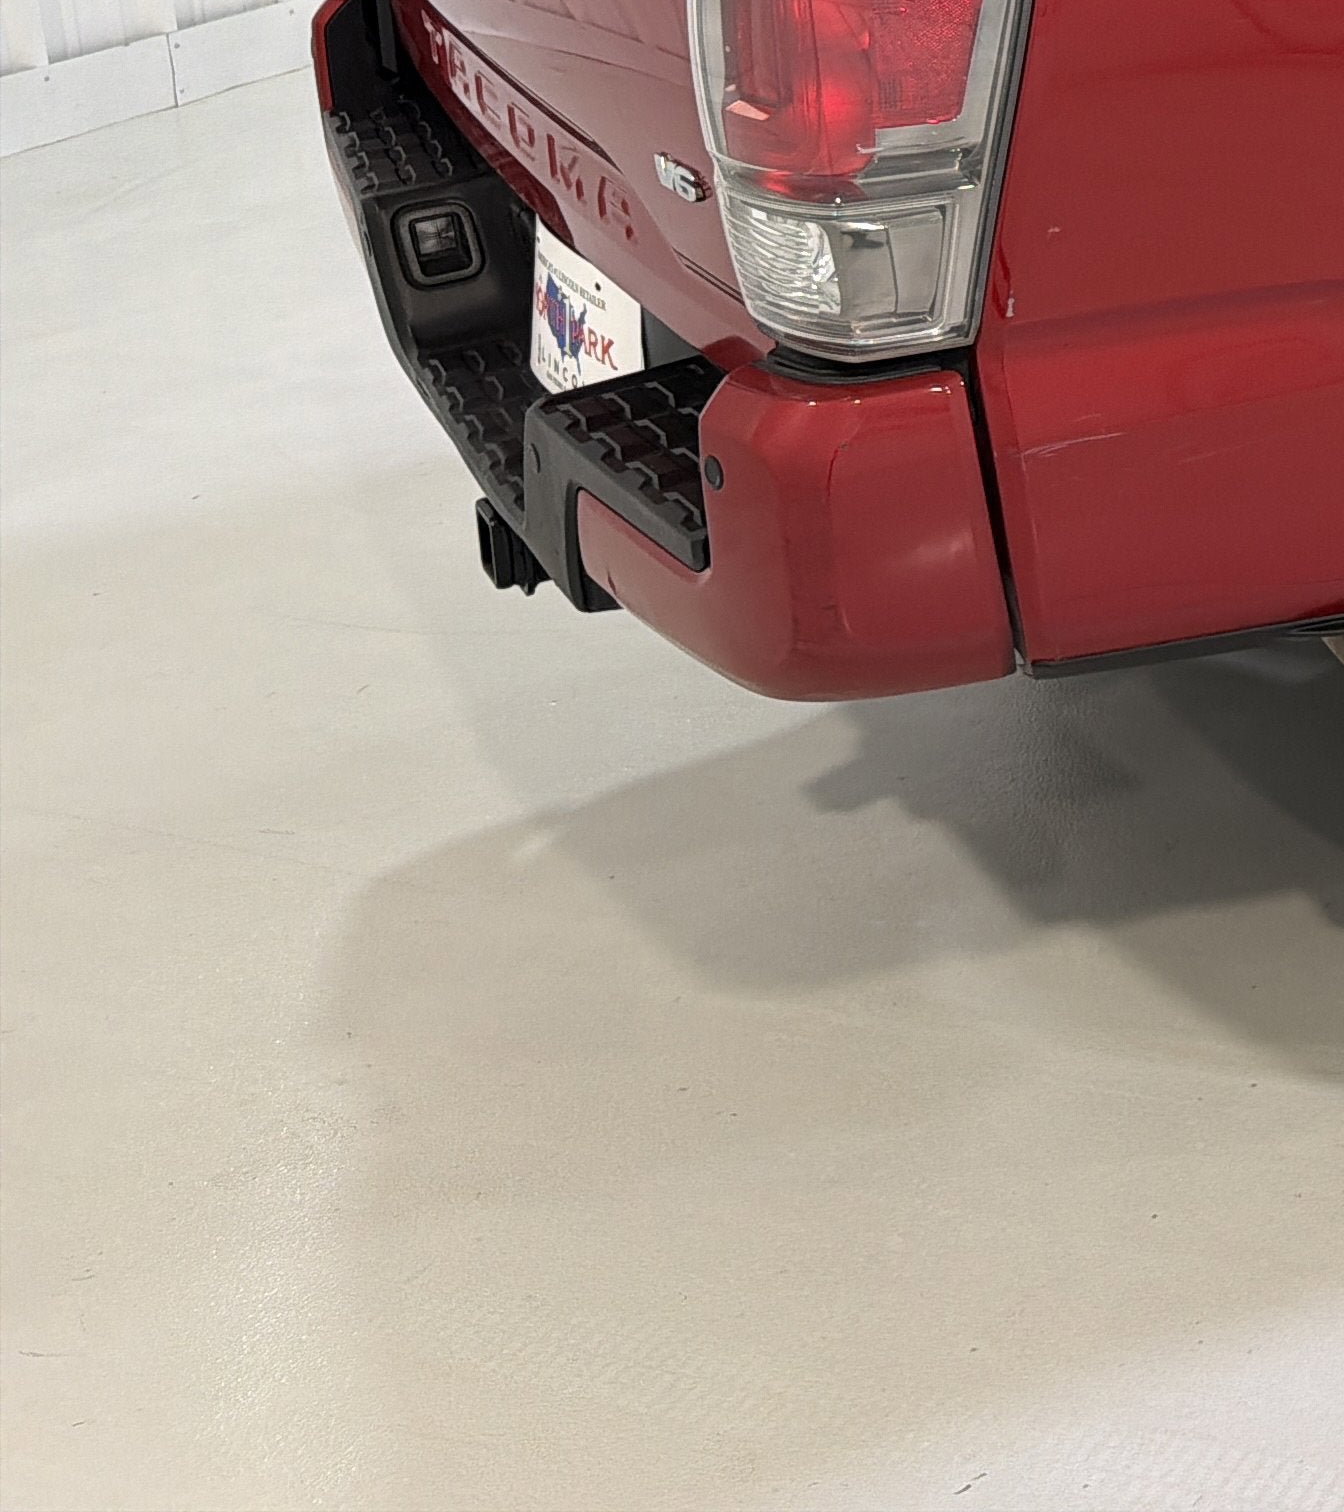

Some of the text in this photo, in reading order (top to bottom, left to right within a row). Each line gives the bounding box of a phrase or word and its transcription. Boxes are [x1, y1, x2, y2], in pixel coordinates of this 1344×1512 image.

[421, 8, 636, 242] TACOMA
[653, 152, 705, 202] V6
[569, 315, 618, 371] PARK
